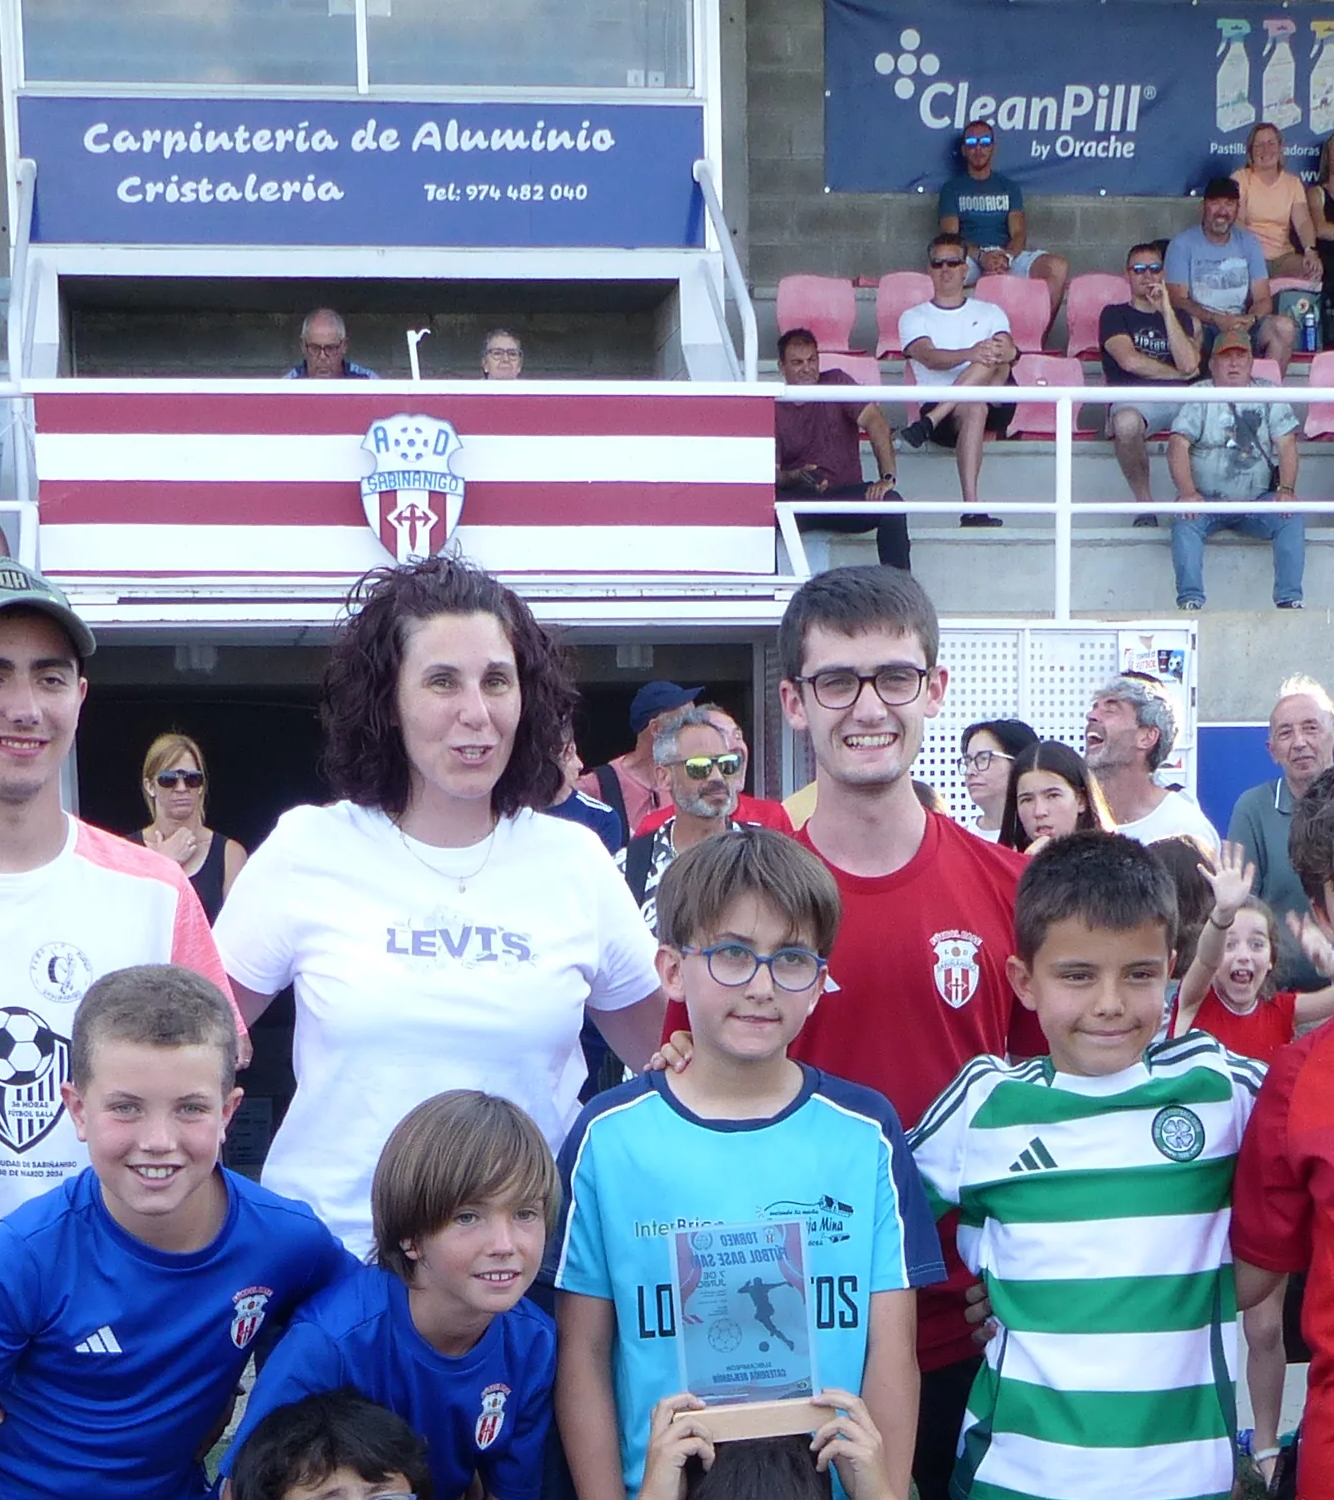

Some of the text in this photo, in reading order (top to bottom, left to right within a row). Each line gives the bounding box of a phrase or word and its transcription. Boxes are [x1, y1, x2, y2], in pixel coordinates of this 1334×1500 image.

[82, 118, 616, 159] Carpintería de Aluminio
[1031, 135, 1136, 160] by Orache
[423, 183, 461, 201] Tel:
[466, 184, 501, 201] 974
[506, 184, 545, 201] 482
[549, 184, 588, 201] 040
[958, 194, 1010, 213] HOODRICH
[373, 425, 450, 456] A D
